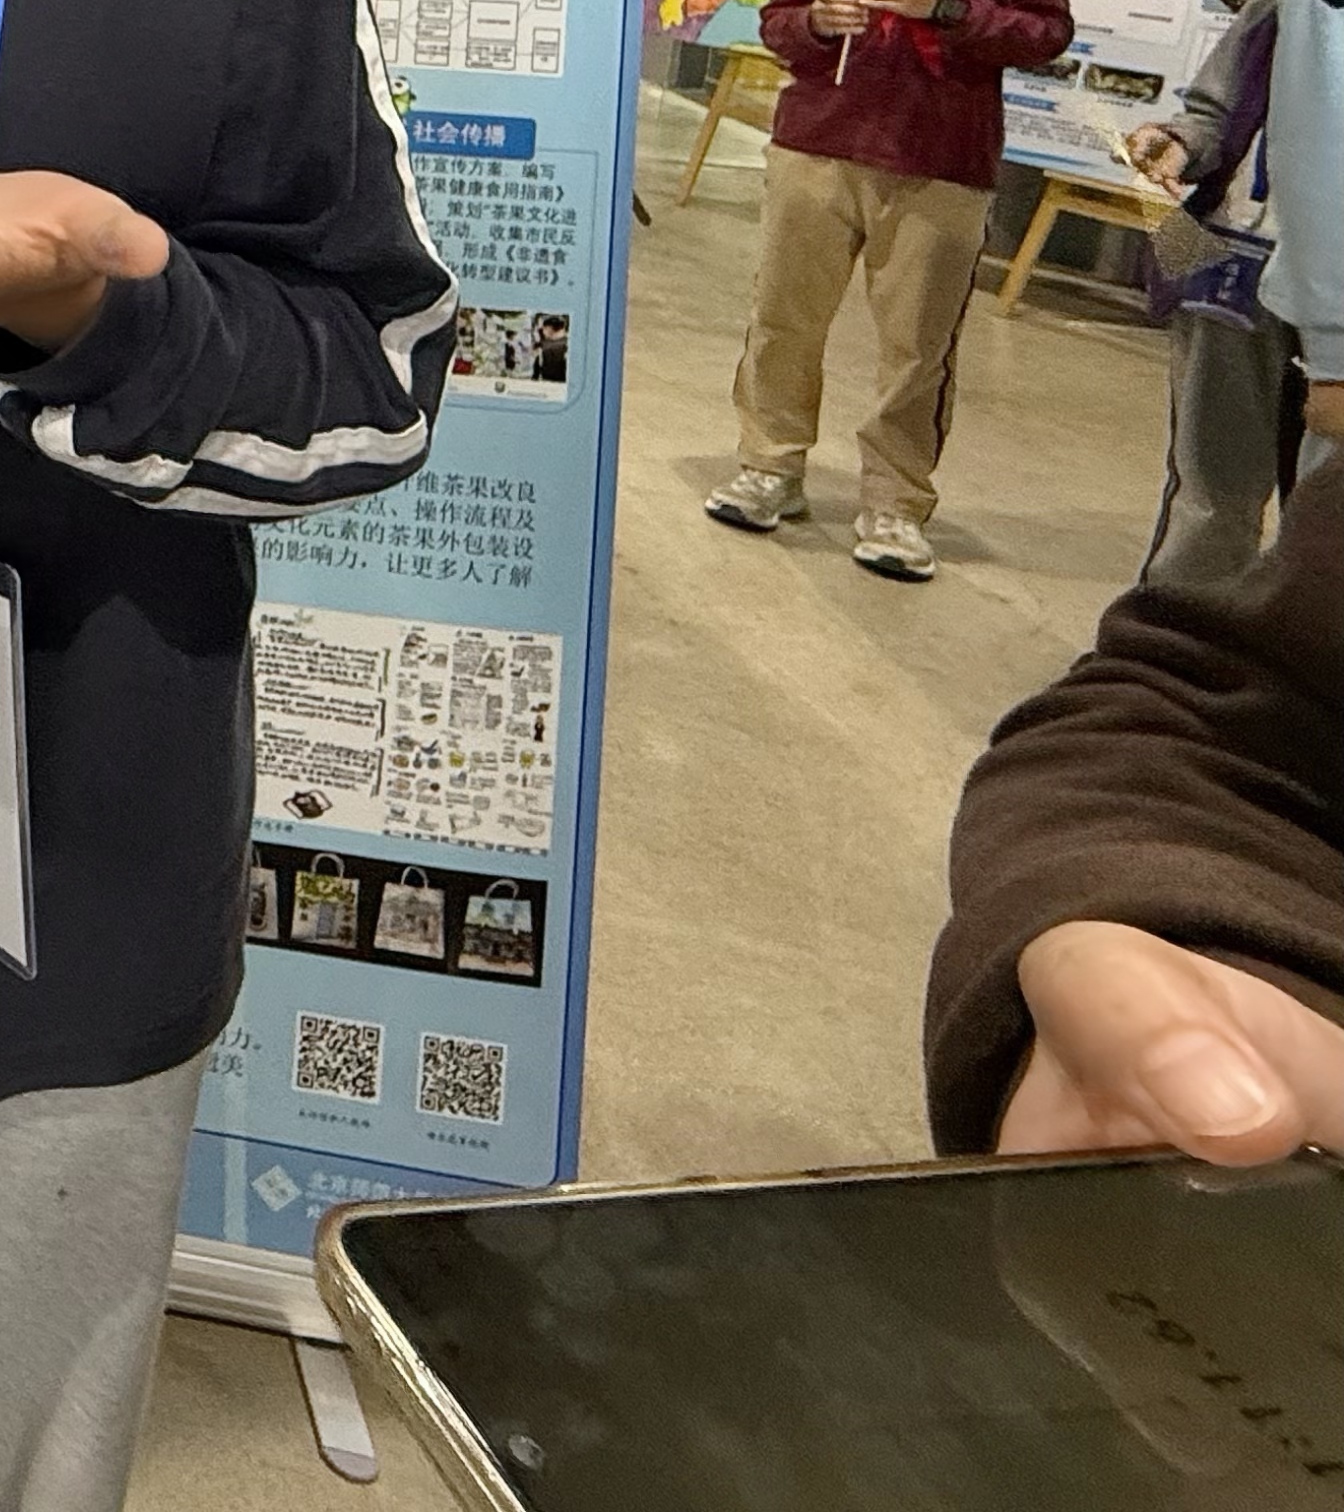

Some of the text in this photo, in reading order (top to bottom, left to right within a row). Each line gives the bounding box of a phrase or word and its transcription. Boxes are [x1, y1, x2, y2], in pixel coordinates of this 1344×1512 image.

[414, 120, 506, 147] 社会传播
[251, 518, 534, 560] 文化元素的茶果外包装设
[252, 540, 533, 589] 的影响力，让更多人了解
